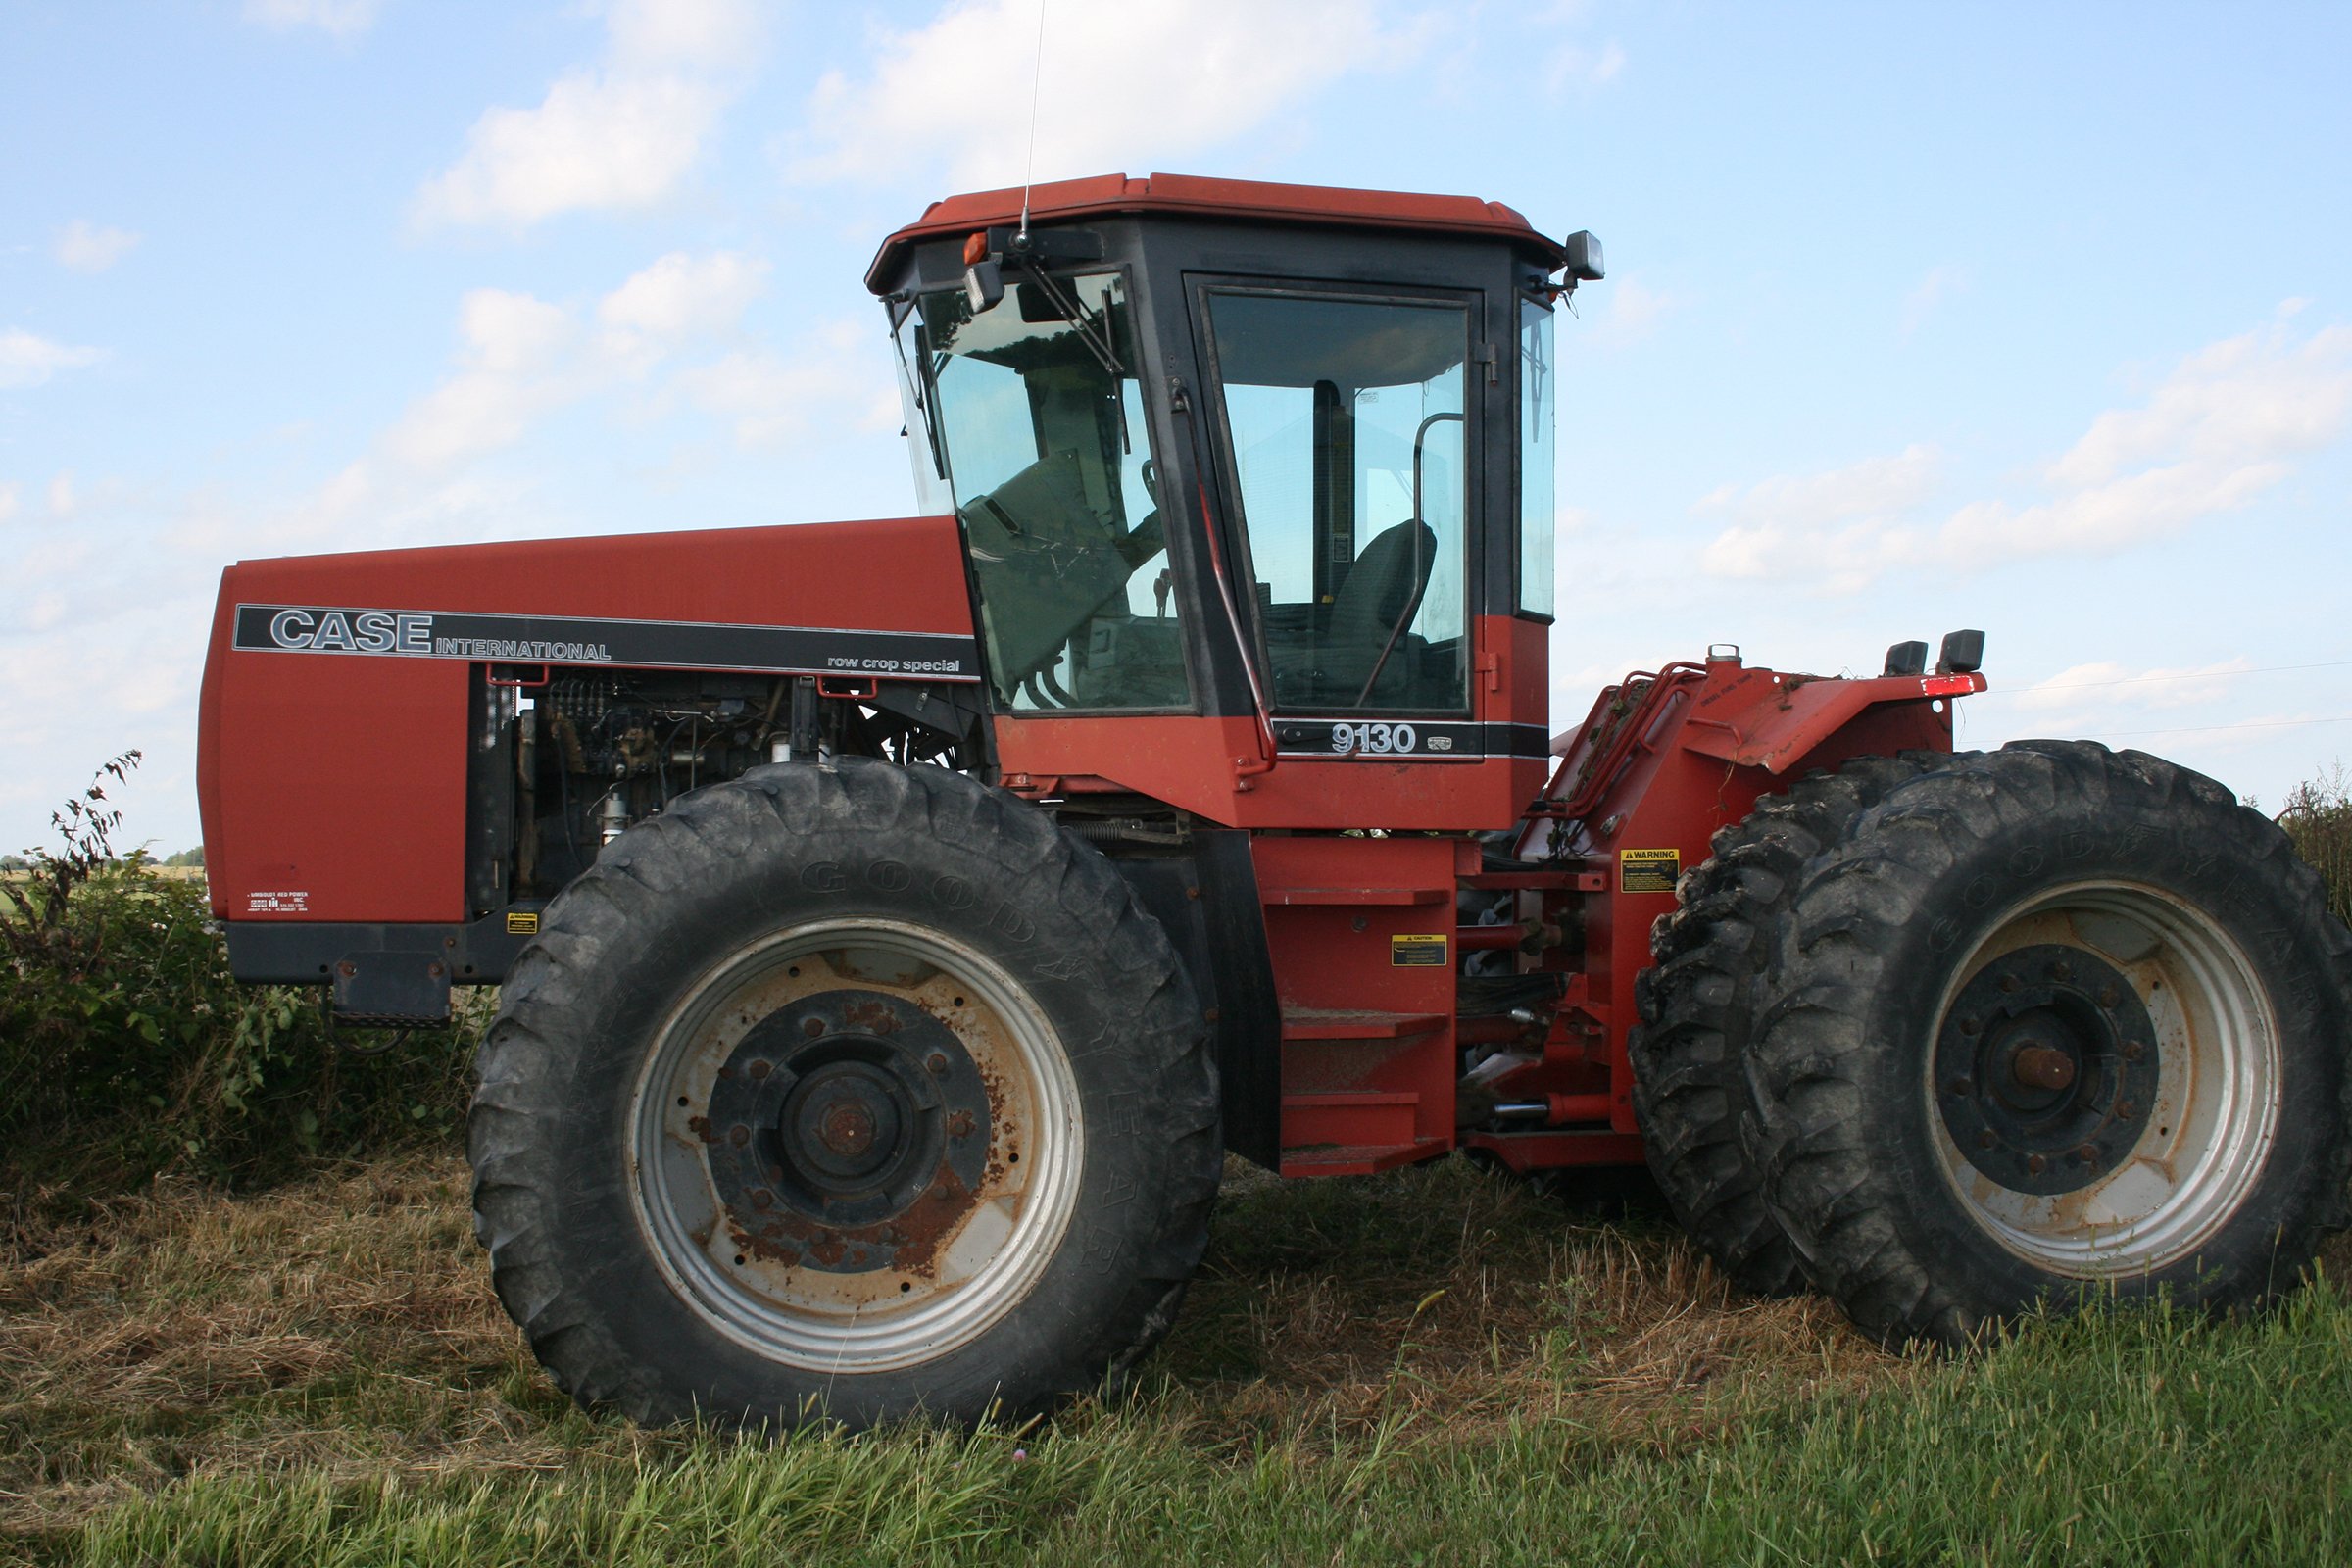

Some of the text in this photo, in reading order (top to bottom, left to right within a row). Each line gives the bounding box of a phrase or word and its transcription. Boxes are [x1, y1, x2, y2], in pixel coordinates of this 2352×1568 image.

[270, 610, 612, 661] CASE INTERNATIONAL
[827, 657, 960, 673] row crop special
[1331, 723, 1417, 754] 9130
